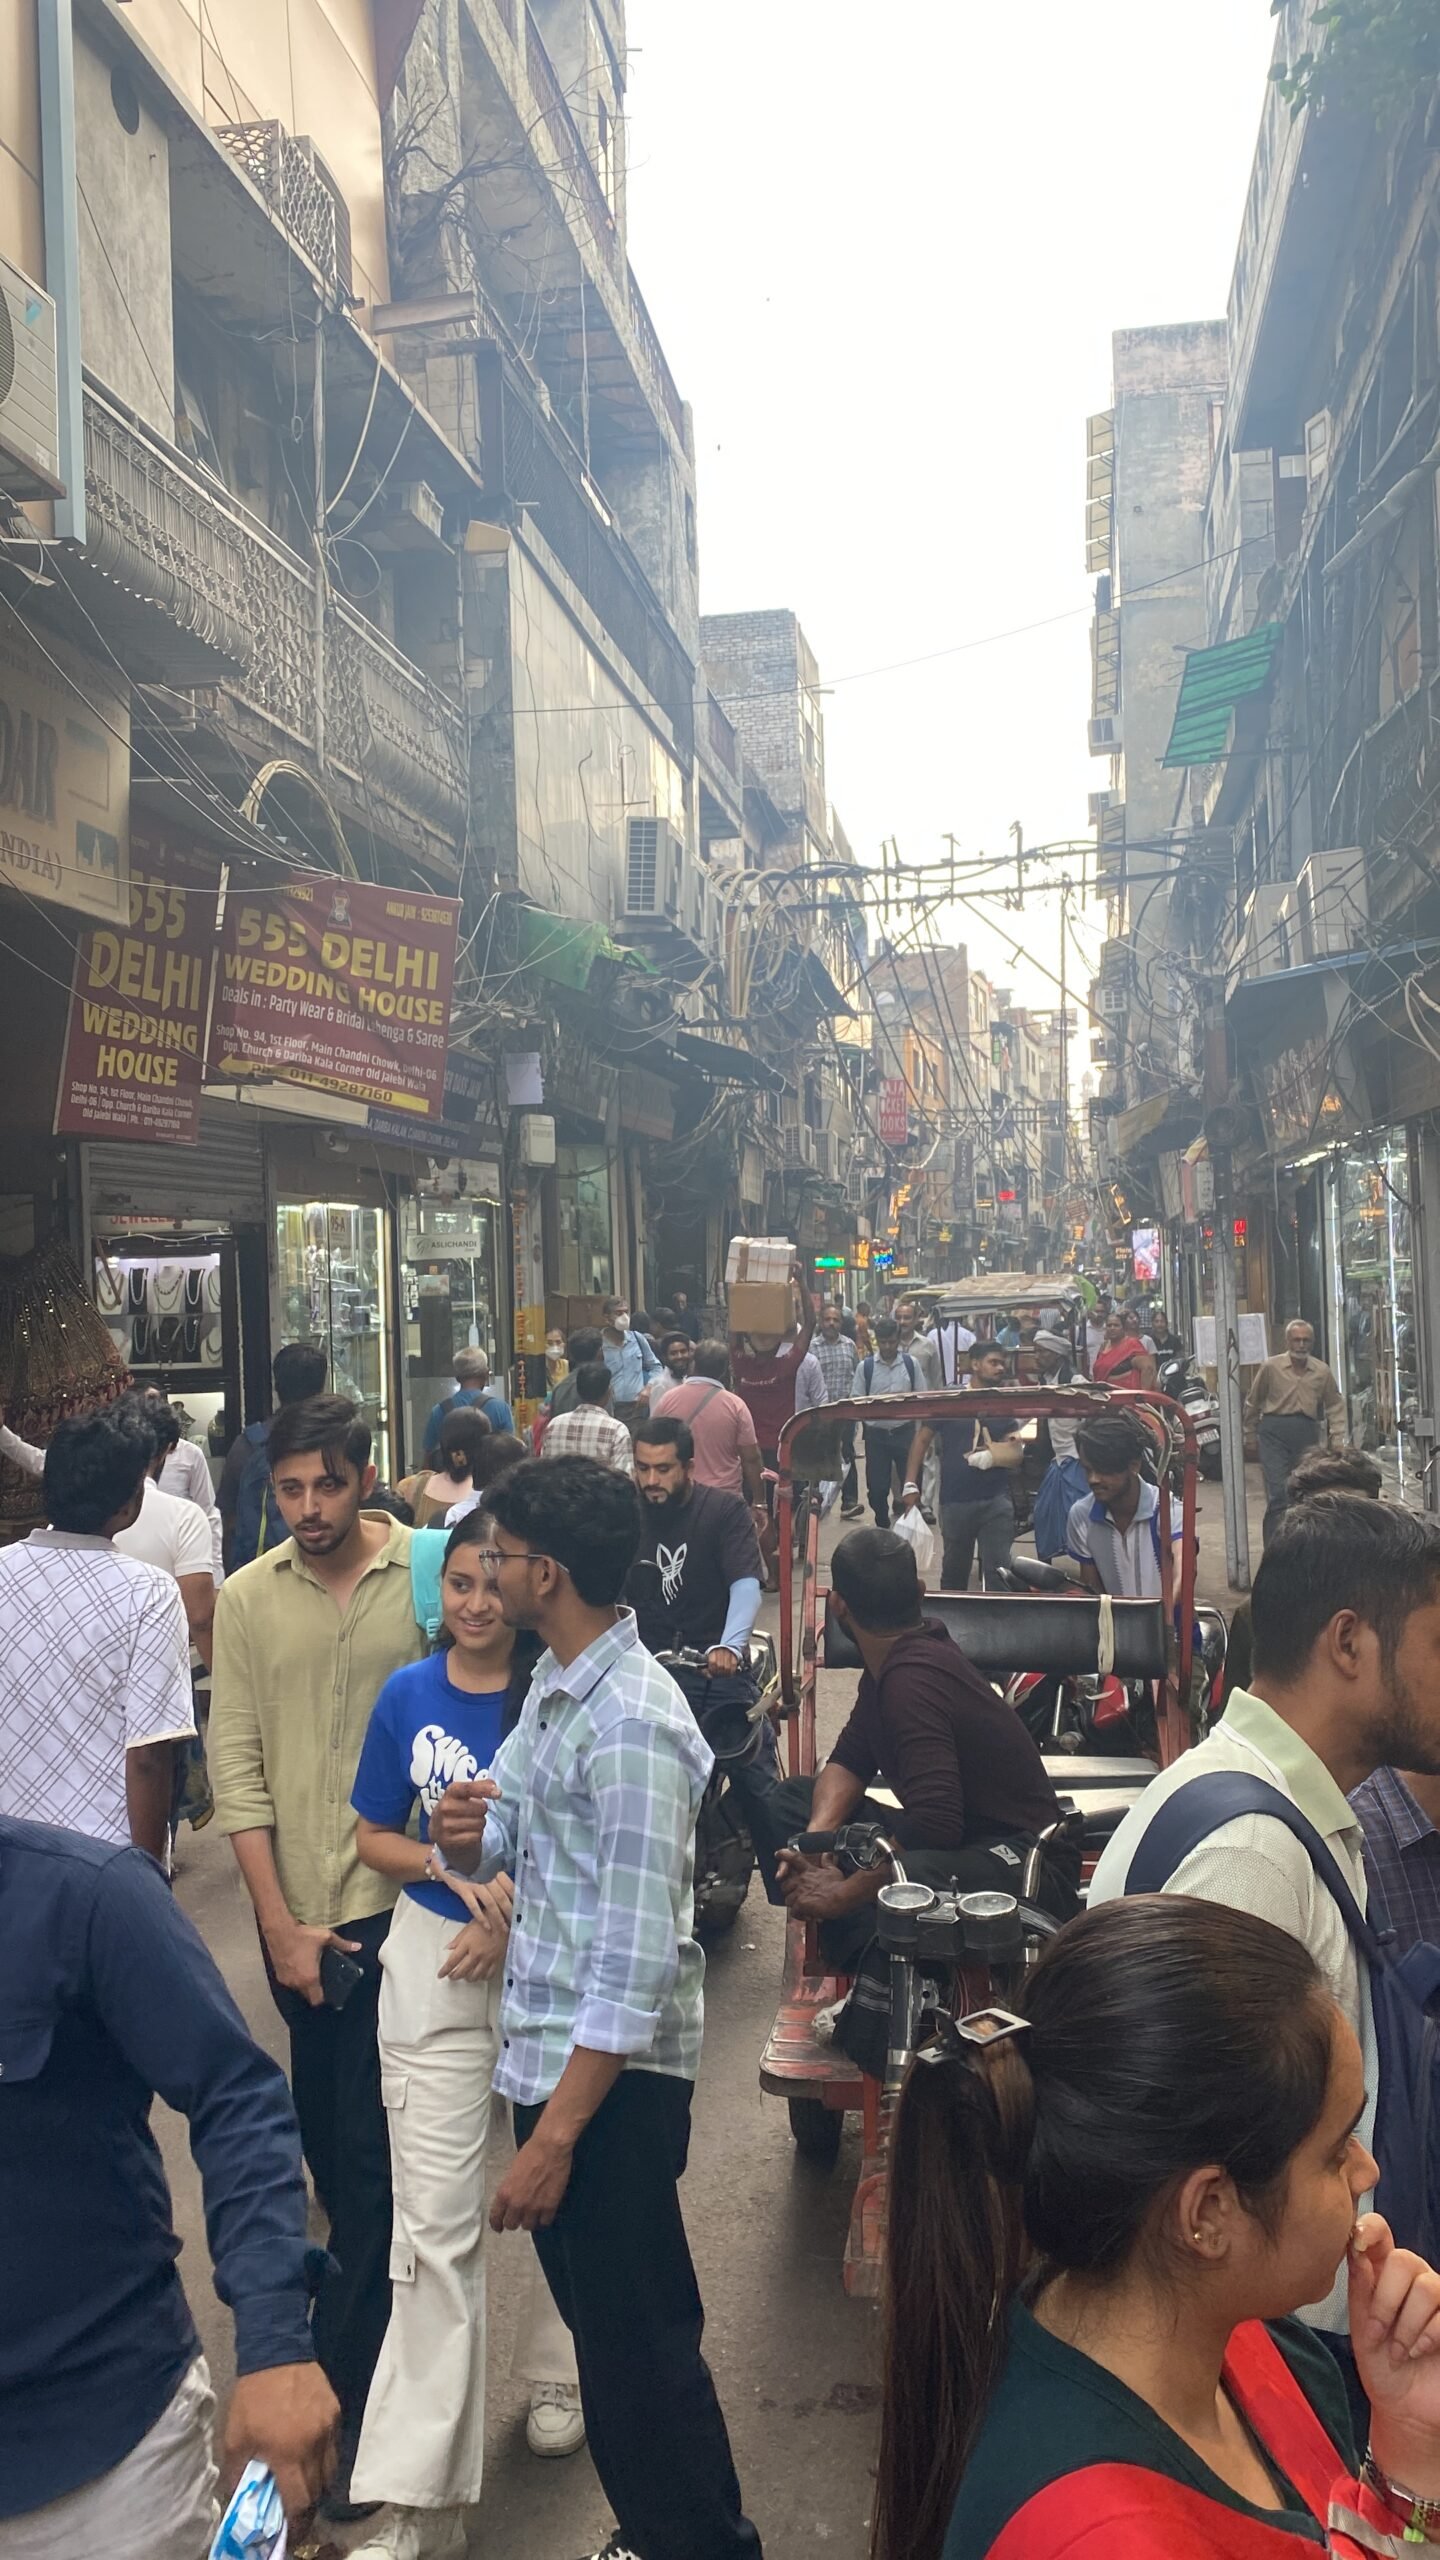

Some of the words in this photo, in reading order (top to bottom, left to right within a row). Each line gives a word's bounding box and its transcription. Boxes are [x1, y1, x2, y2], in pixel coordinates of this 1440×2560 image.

[131, 868, 187, 938] 555
[88, 931, 202, 1011] DELHI
[239, 907, 308, 957] 555
[321, 932, 439, 991] DELHI
[224, 953, 351, 1005] WEDDING
[358, 986, 444, 1026] HOUSE
[83, 1001, 198, 1054] WEDDING
[222, 986, 250, 1005] Deals
[250, 989, 262, 1008] in
[269, 995, 298, 1018] Party
[300, 1000, 326, 1020] Wear
[327, 1006, 335, 1022] &
[336, 1009, 365, 1030] Bridal
[407, 1027, 414, 1043] &
[416, 1029, 445, 1049] Saree
[97, 1045, 178, 1086] HOUSE
[216, 1024, 235, 1038] Shop
[237, 1027, 251, 1040] No.
[254, 1030, 267, 1045] 94,
[270, 1034, 282, 1046] 1st
[284, 1036, 309, 1051] Floor,
[311, 1041, 333, 1057] Main
[334, 1046, 370, 1064] Chandni
[371, 1055, 401, 1073] Chowk,
[402, 1063, 437, 1081] Delhi-06
[242, 1042, 273, 1059] Church
[275, 1048, 282, 1057] &
[283, 1049, 313, 1065] Dariba
[314, 1055, 334, 1071] Kala
[335, 1061, 366, 1077] Corner
[366, 1067, 381, 1081] Old
[381, 1071, 405, 1084] Jalebi
[407, 1077, 427, 1093] Wala
[71, 1081, 88, 1094] Shop
[116, 1100, 136, 1112] Church
[290, 1068, 393, 1103] 011-49287160
[82, 1108, 94, 1118] Old
[431, 1240, 477, 1249] ASLICHANDI
